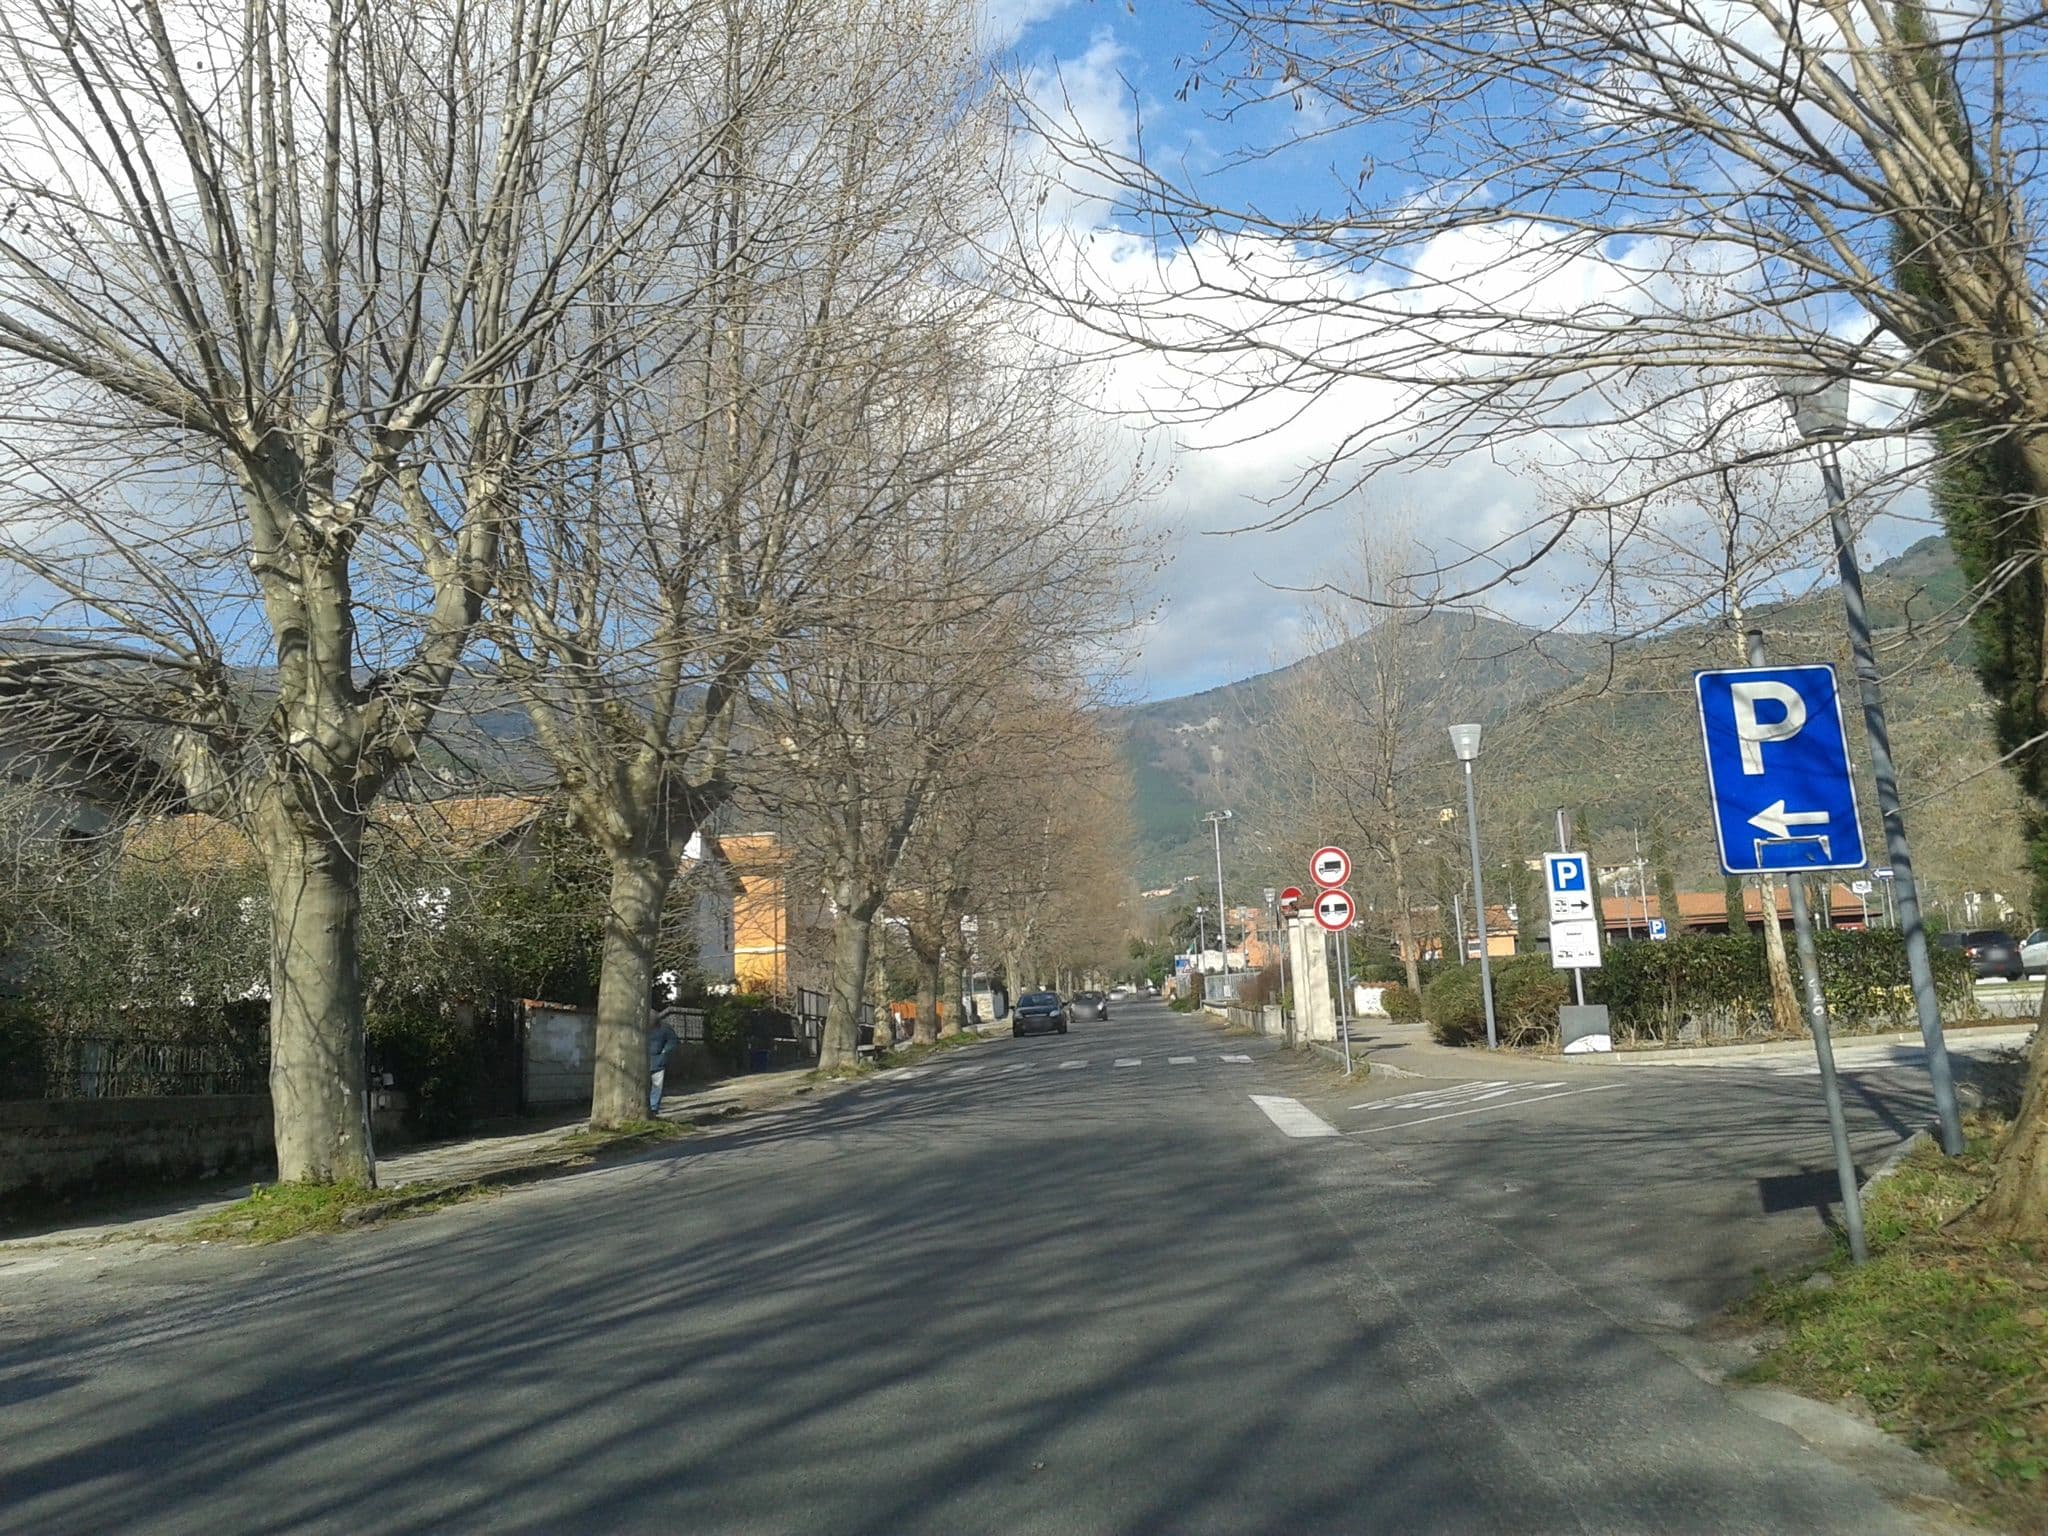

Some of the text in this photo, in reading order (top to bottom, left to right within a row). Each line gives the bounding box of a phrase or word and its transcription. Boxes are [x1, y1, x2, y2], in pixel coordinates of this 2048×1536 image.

[1731, 681, 1806, 775] P
[1557, 861, 1577, 889] P
[1652, 920, 1663, 934] P
